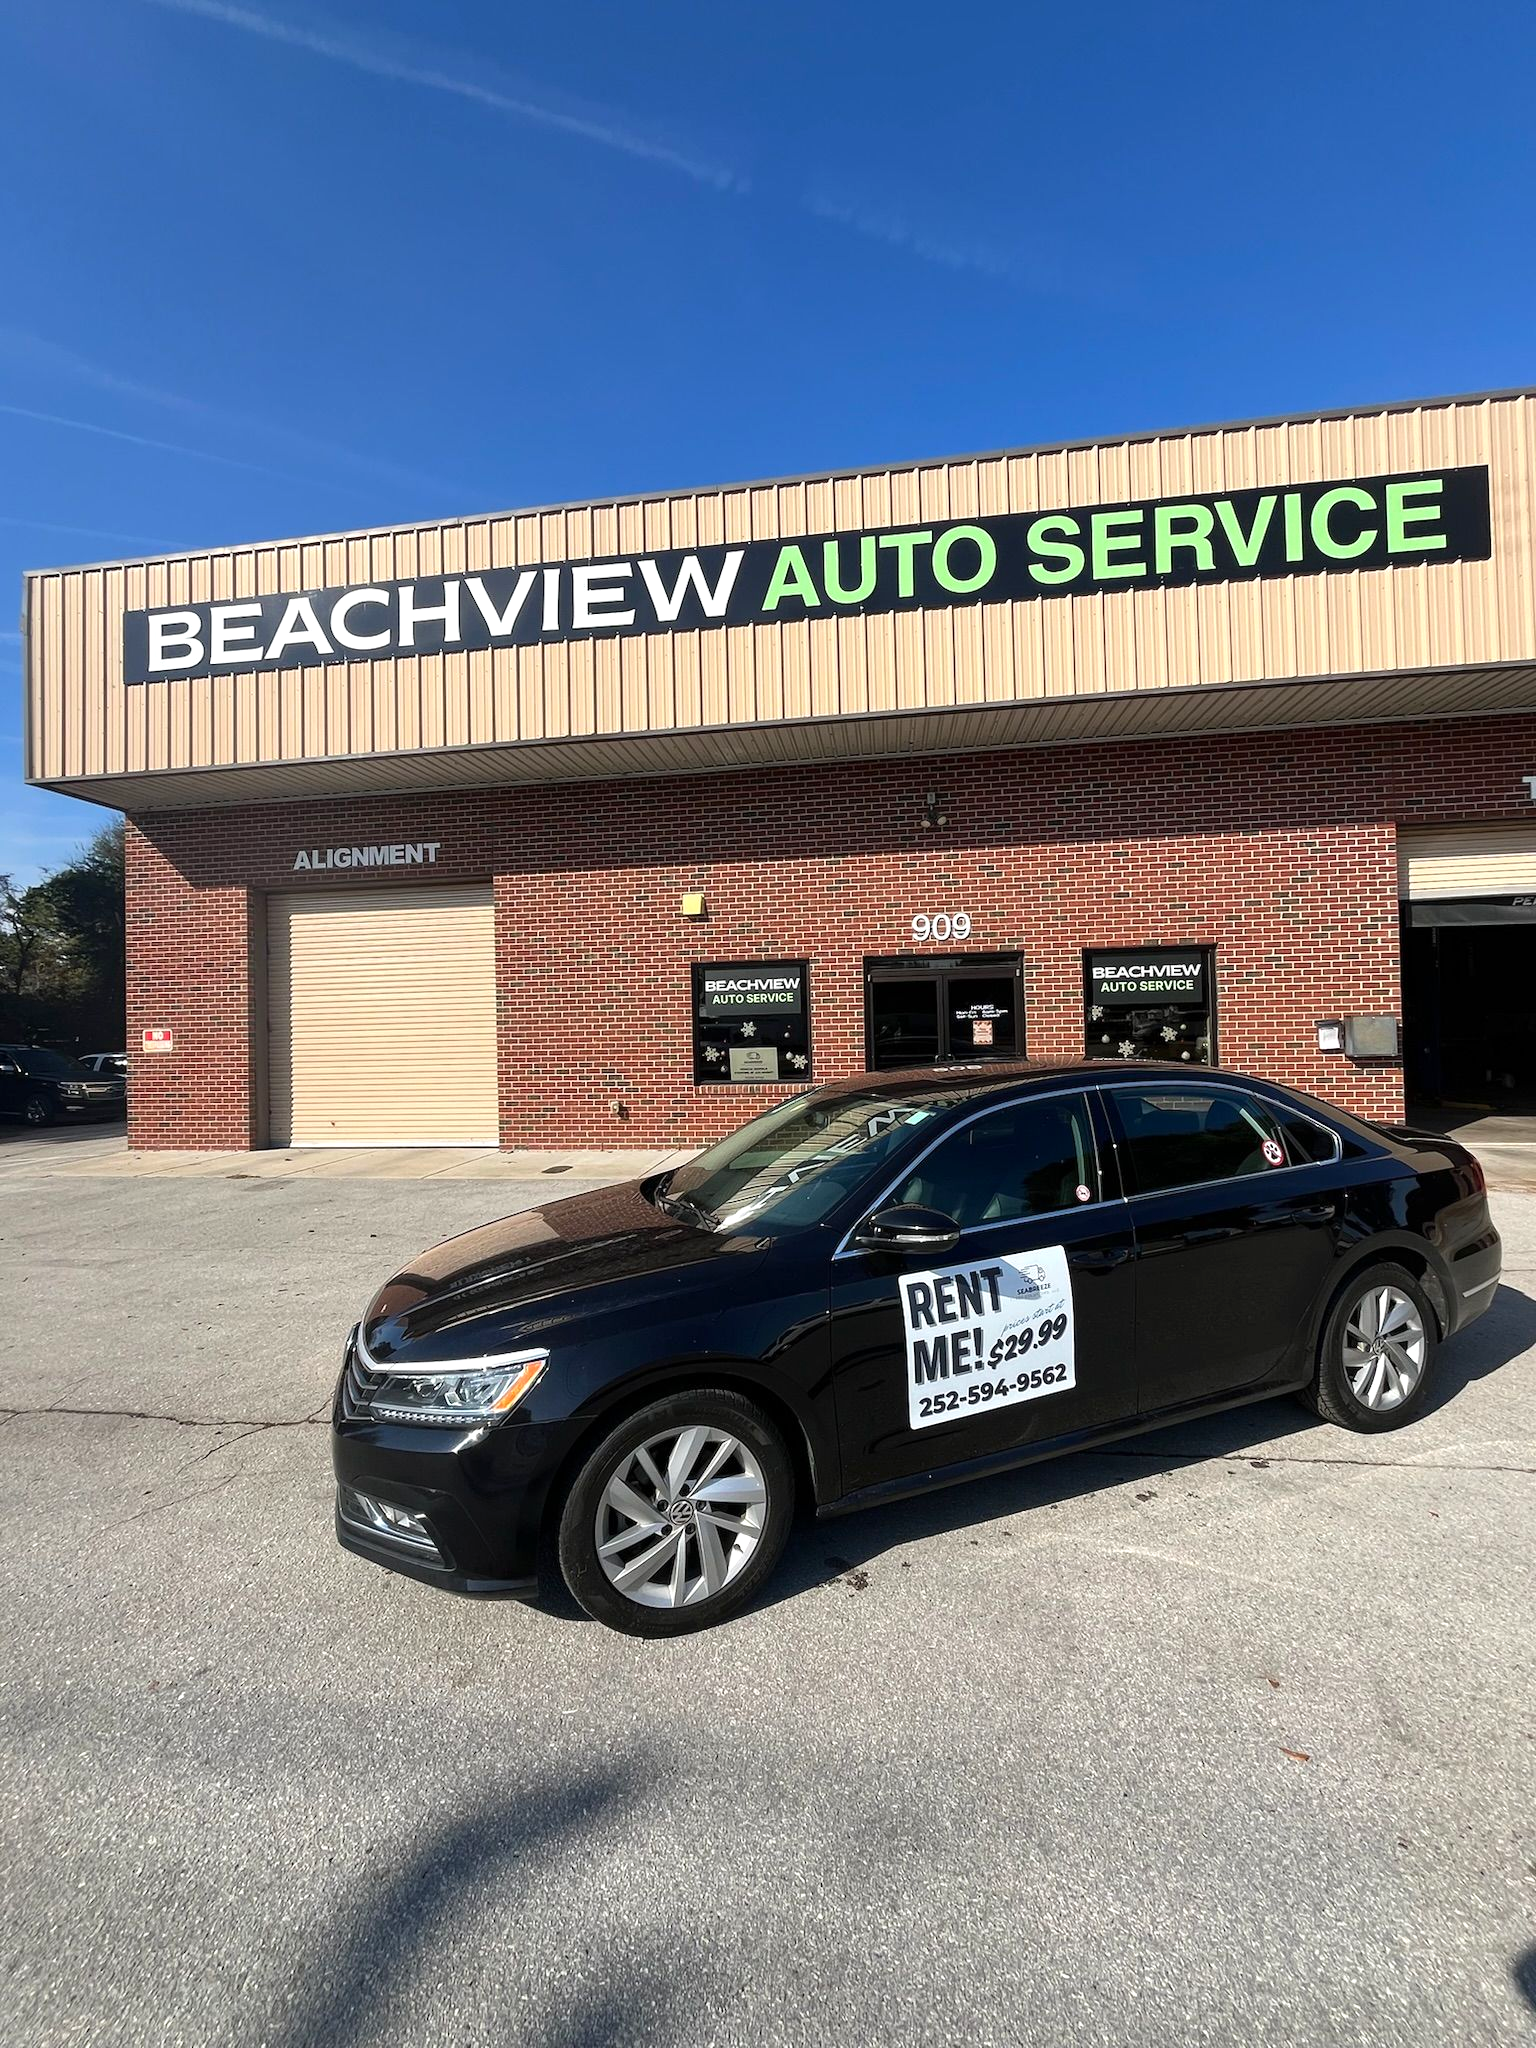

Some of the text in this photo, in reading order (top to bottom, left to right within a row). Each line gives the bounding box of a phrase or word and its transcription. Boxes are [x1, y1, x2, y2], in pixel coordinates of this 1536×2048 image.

[147, 478, 1449, 672] BEACHVIEW AUTO SERVICE
[293, 843, 440, 870] ALIGNMENT
[1512, 896, 1536, 906] PE
[912, 913, 971, 941] 909
[705, 978, 800, 992] BEACHVIEW
[1092, 963, 1201, 979] BEACHVIEW
[712, 992, 794, 1004] AUTO SERVICE
[1101, 980, 1194, 992] AUTO SERVICE
[907, 1267, 1003, 1329] RENT
[1000, 1298, 1065, 1336] prices start at
[987, 1313, 1067, 1369] $29.99
[913, 1327, 984, 1385] ME!
[919, 1363, 1067, 1417] 252-594-9562
